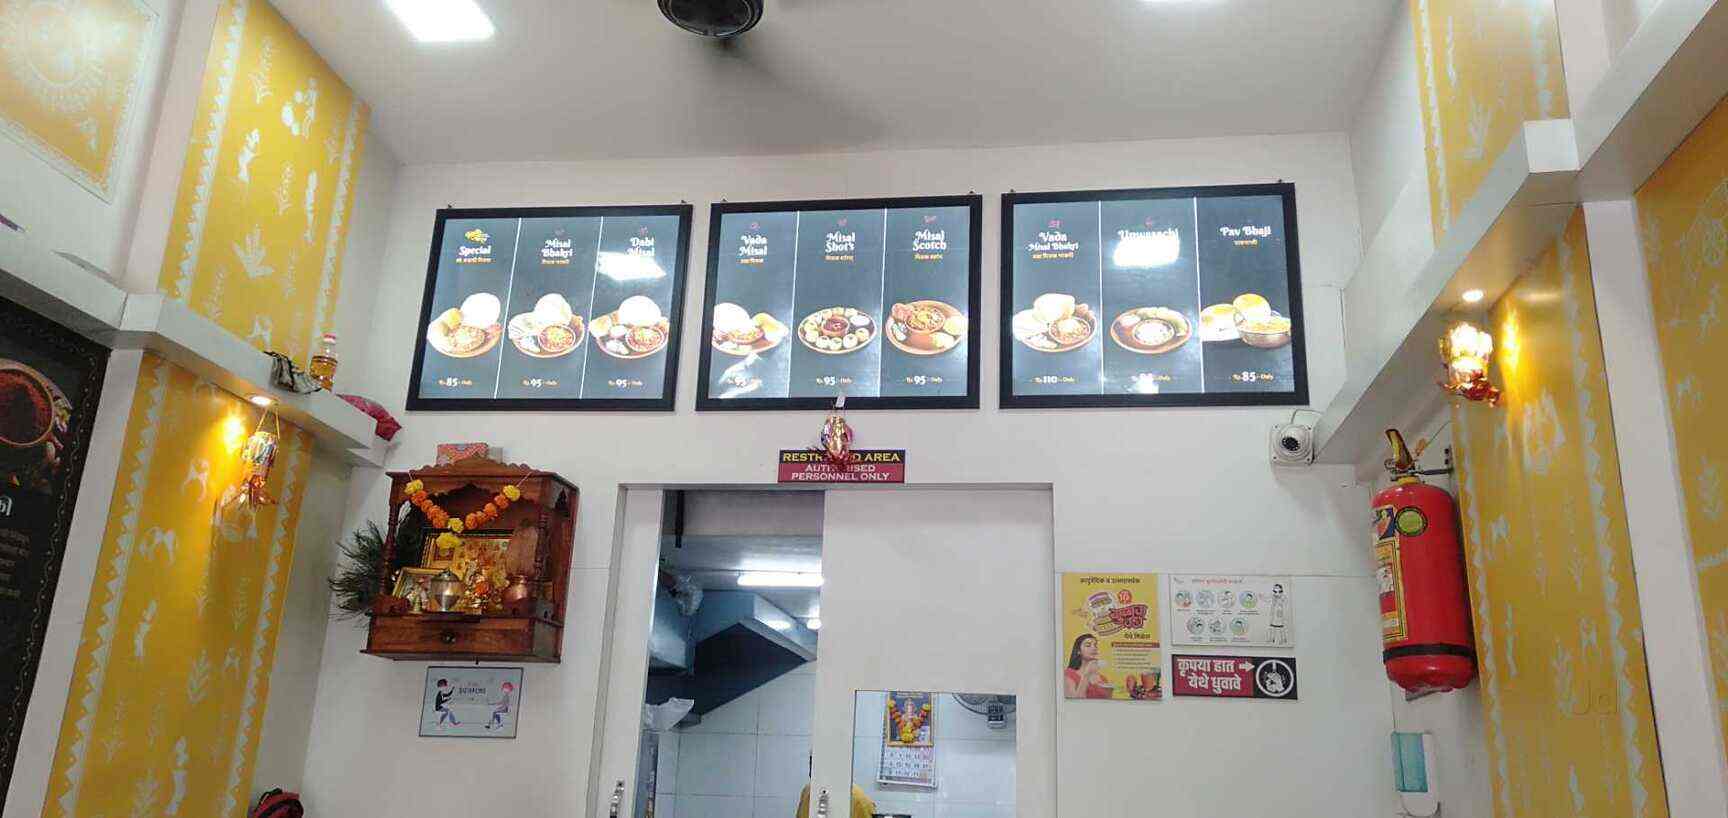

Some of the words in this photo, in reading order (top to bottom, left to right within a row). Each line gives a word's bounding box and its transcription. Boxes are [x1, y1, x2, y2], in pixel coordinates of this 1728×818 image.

[825, 231, 856, 242] Misal
[915, 228, 945, 241] Misal
[1038, 231, 1067, 242] Vada
[1219, 226, 1240, 237] Pav
[1242, 225, 1271, 237] Bhaji
[544, 237, 571, 248] Misal
[740, 234, 768, 245] Vada
[458, 245, 492, 256] Special
[739, 244, 768, 256] Misal
[912, 240, 946, 251] Scotch
[1027, 242, 1051, 251] Misal
[783, 452, 861, 462] RESTRD
[864, 452, 901, 462] AREA
[804, 463, 876, 473] AUTISED
[791, 472, 857, 481] PERSONNEL
[860, 472, 890, 481] ONLY
[1177, 659, 1211, 677] कृपया
[1187, 672, 1209, 689] येथे
